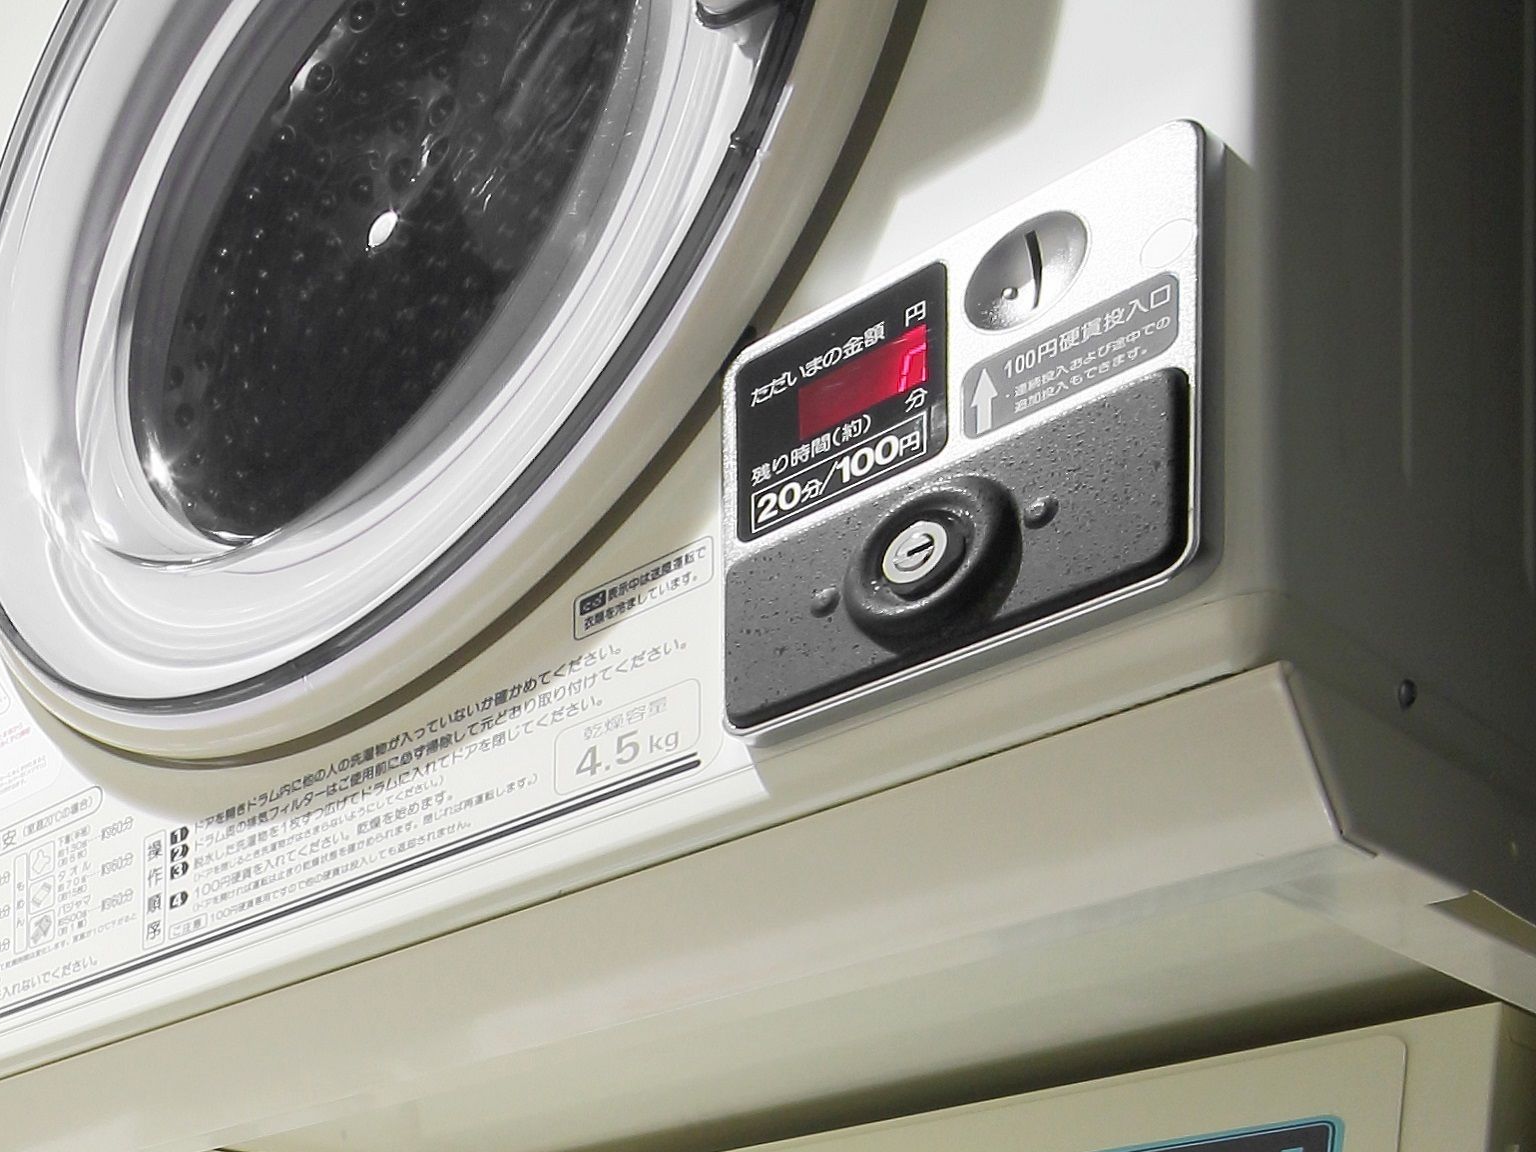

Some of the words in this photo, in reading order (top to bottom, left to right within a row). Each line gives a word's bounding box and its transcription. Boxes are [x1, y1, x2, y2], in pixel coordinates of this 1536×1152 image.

[905, 300, 926, 327] 円
[1003, 284, 1171, 379] 100円硬貨投入口
[750, 321, 886, 407] ただいまの金額
[905, 386, 928, 413] 分
[756, 430, 921, 524] 20分/100円
[583, 696, 667, 742] 乾燥容量
